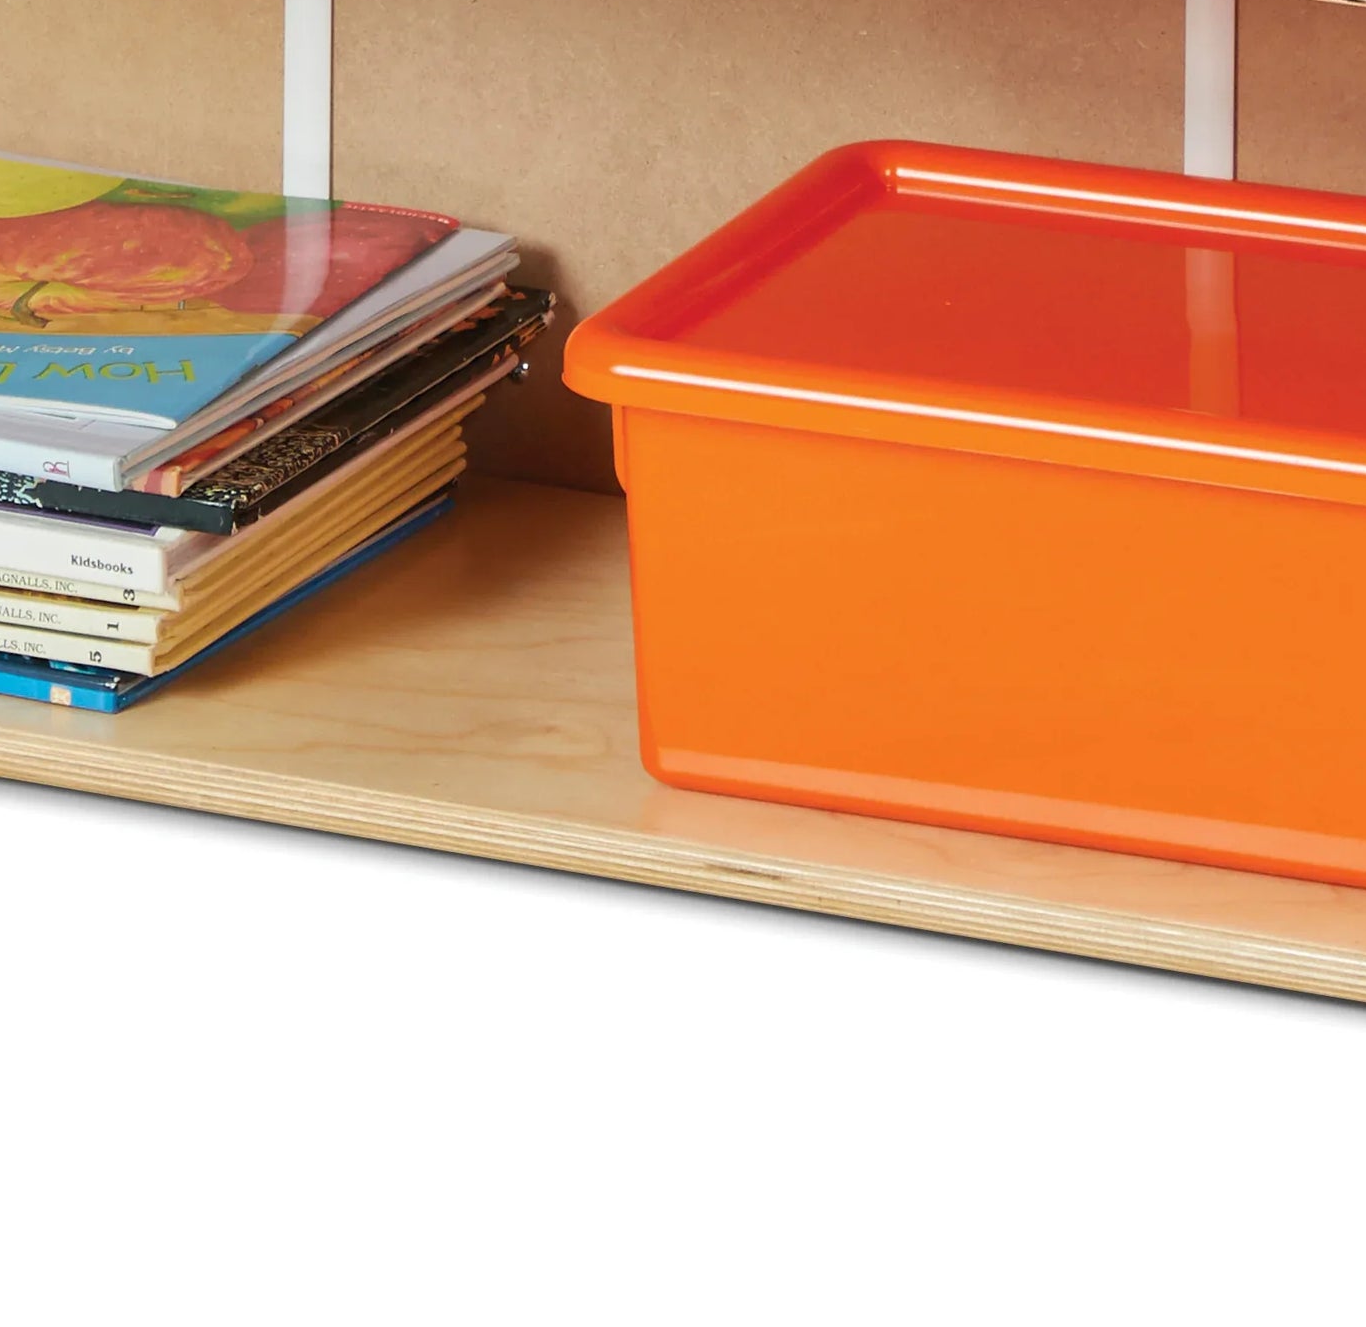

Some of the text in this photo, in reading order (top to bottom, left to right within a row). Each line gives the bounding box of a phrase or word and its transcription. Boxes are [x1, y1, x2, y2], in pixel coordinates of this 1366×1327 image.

[34, 358, 197, 384] How
[70, 554, 134, 576] Kidsbooks
[55, 580, 78, 594] INC.
[123, 588, 136, 602] 3
[38, 611, 62, 625] INC.
[24, 640, 47, 655] INC.
[89, 650, 102, 663] 5
